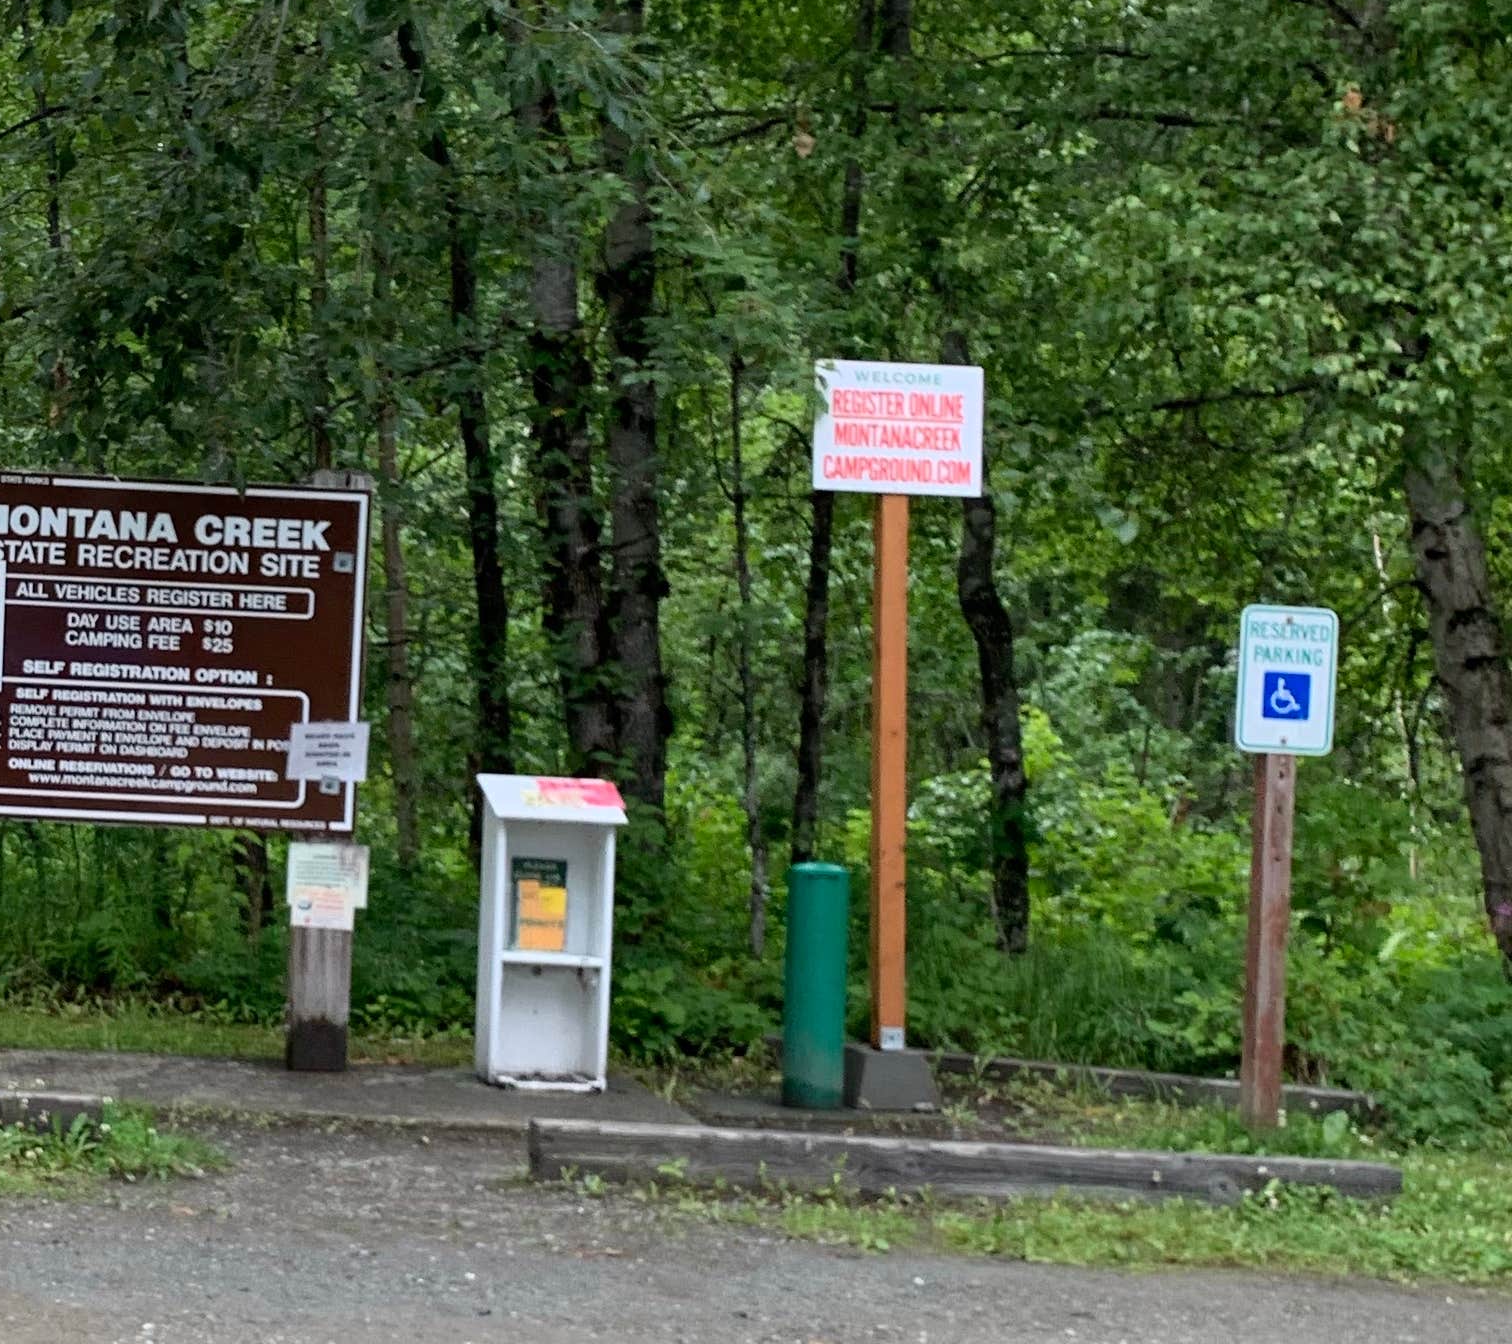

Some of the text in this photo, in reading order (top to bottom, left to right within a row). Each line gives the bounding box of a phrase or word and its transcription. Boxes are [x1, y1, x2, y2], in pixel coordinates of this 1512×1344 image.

[855, 370, 942, 386] WELCOME
[832, 388, 964, 418] REGISTER ONLINE
[834, 423, 961, 451] MONTANACREEK
[823, 454, 971, 486] CAMPGROUND.COM
[194, 514, 331, 551] CREEK
[78, 544, 249, 575] RECREATION
[260, 553, 320, 578] SITE
[16, 582, 287, 611] ALL VEHICLES REGISTER HERE
[67, 613, 233, 635] DAY USE AREA $10
[1250, 621, 1330, 641] RESERVED
[65, 630, 234, 654] CAMPING FEE $25
[1254, 644, 1322, 666] PARKING
[23, 660, 65, 674] SELF
[70, 662, 190, 681] REGISTRATION
[195, 668, 258, 686] OPTION
[16, 688, 263, 711] SELF REGISTRATION WITH ENVELOPES
[10, 704, 56, 716] REMOVE
[59, 706, 100, 718] PERMIT
[102, 707, 134, 719] FROM
[138, 708, 196, 722] ENVELOPE
[10, 716, 70, 728] COMPLETE
[72, 718, 146, 732] INFORMATION
[149, 722, 166, 734] ON
[168, 722, 190, 734] FEE
[192, 724, 251, 738] ENVELOPE
[8, 740, 54, 752] DISPLAY
[56, 742, 96, 754] PERMIT
[99, 744, 116, 755] ON
[120, 744, 188, 759] DASHBOARD
[9, 728, 45, 740] PLACE
[48, 730, 98, 742] PAYMENT
[100, 732, 112, 742] IN
[115, 732, 174, 745] ENVELOPE
[176, 736, 200, 748] AND
[202, 737, 250, 750] DEPOSIT
[252, 740, 265, 750] IN
[8, 758, 56, 771] ONLINE
[59, 760, 155, 776] RESERVATIONS
[170, 766, 191, 778] GO
[194, 766, 214, 779] TO
[28, 773, 258, 793] www.montanacreekcampground.com
